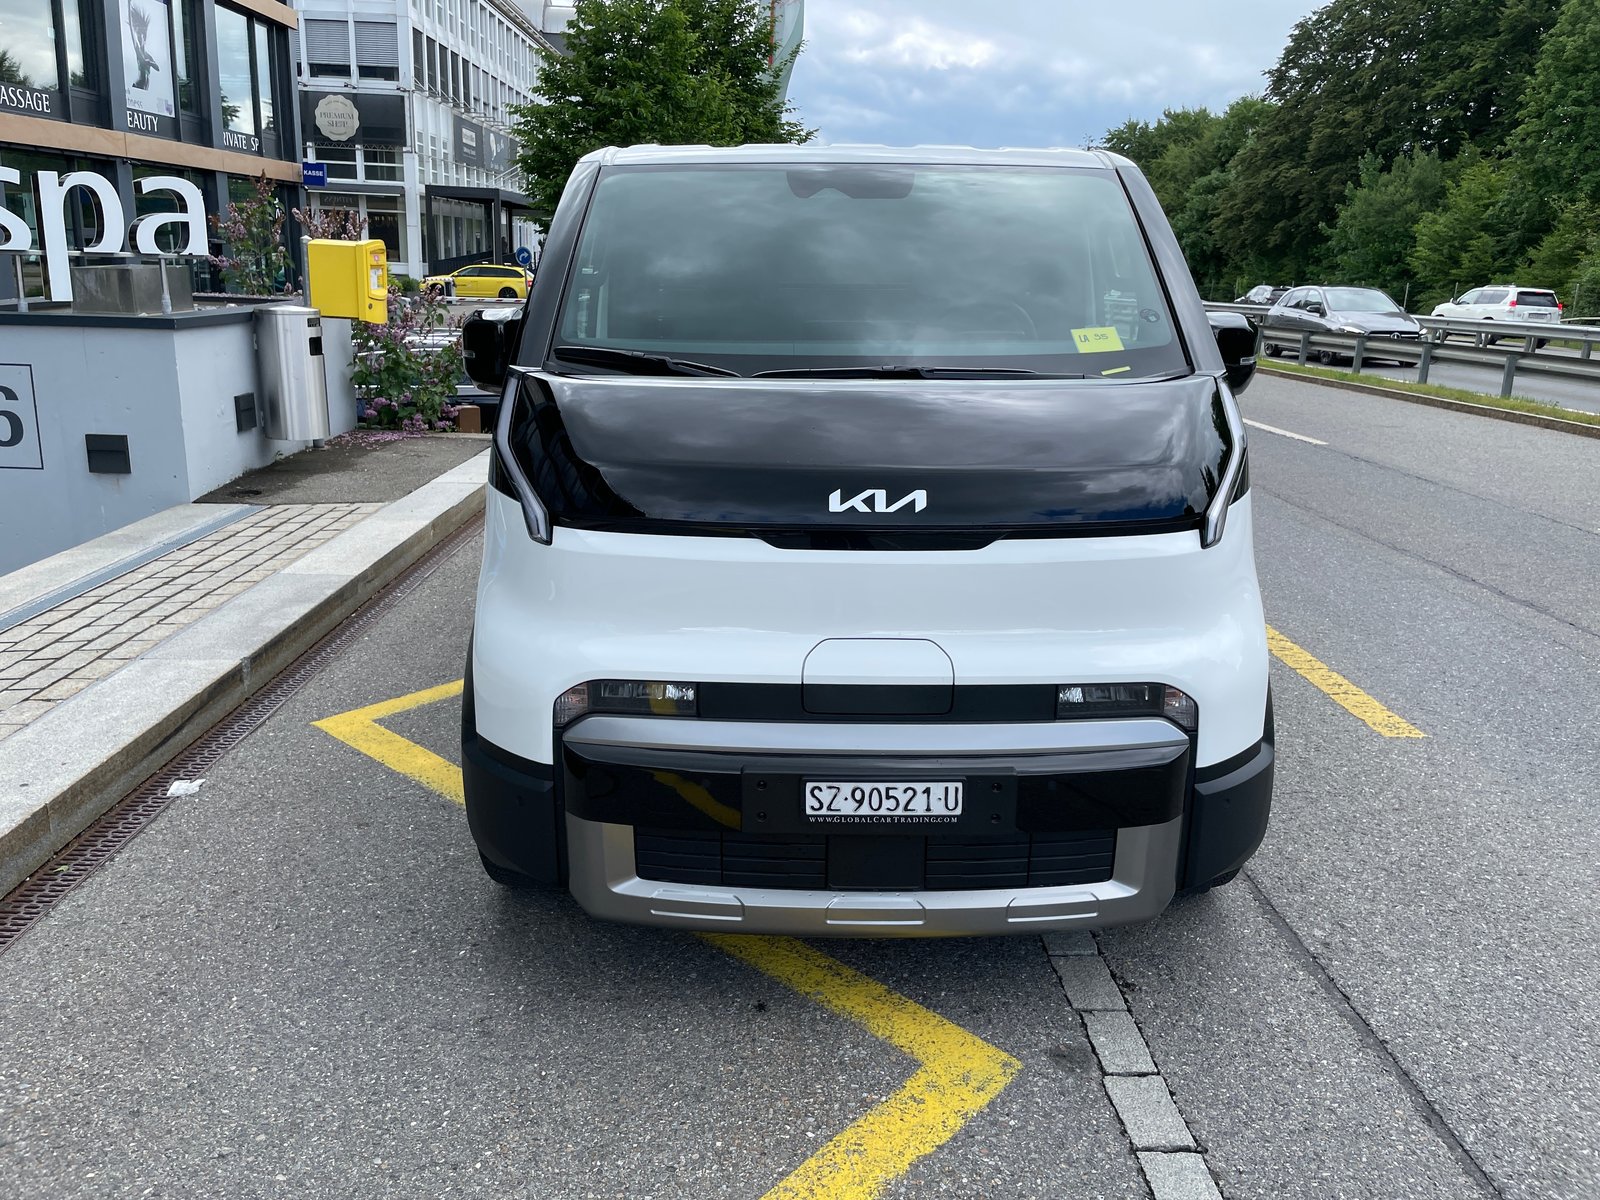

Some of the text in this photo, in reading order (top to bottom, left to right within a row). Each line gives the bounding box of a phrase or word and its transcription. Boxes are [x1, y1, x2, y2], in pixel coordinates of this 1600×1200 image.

[320, 111, 354, 120] PREMIUM
[250, 136, 265, 152] SP
[303, 169, 324, 177] KASSE
[0, 165, 209, 302] spa
[828, 488, 927, 513] KIA
